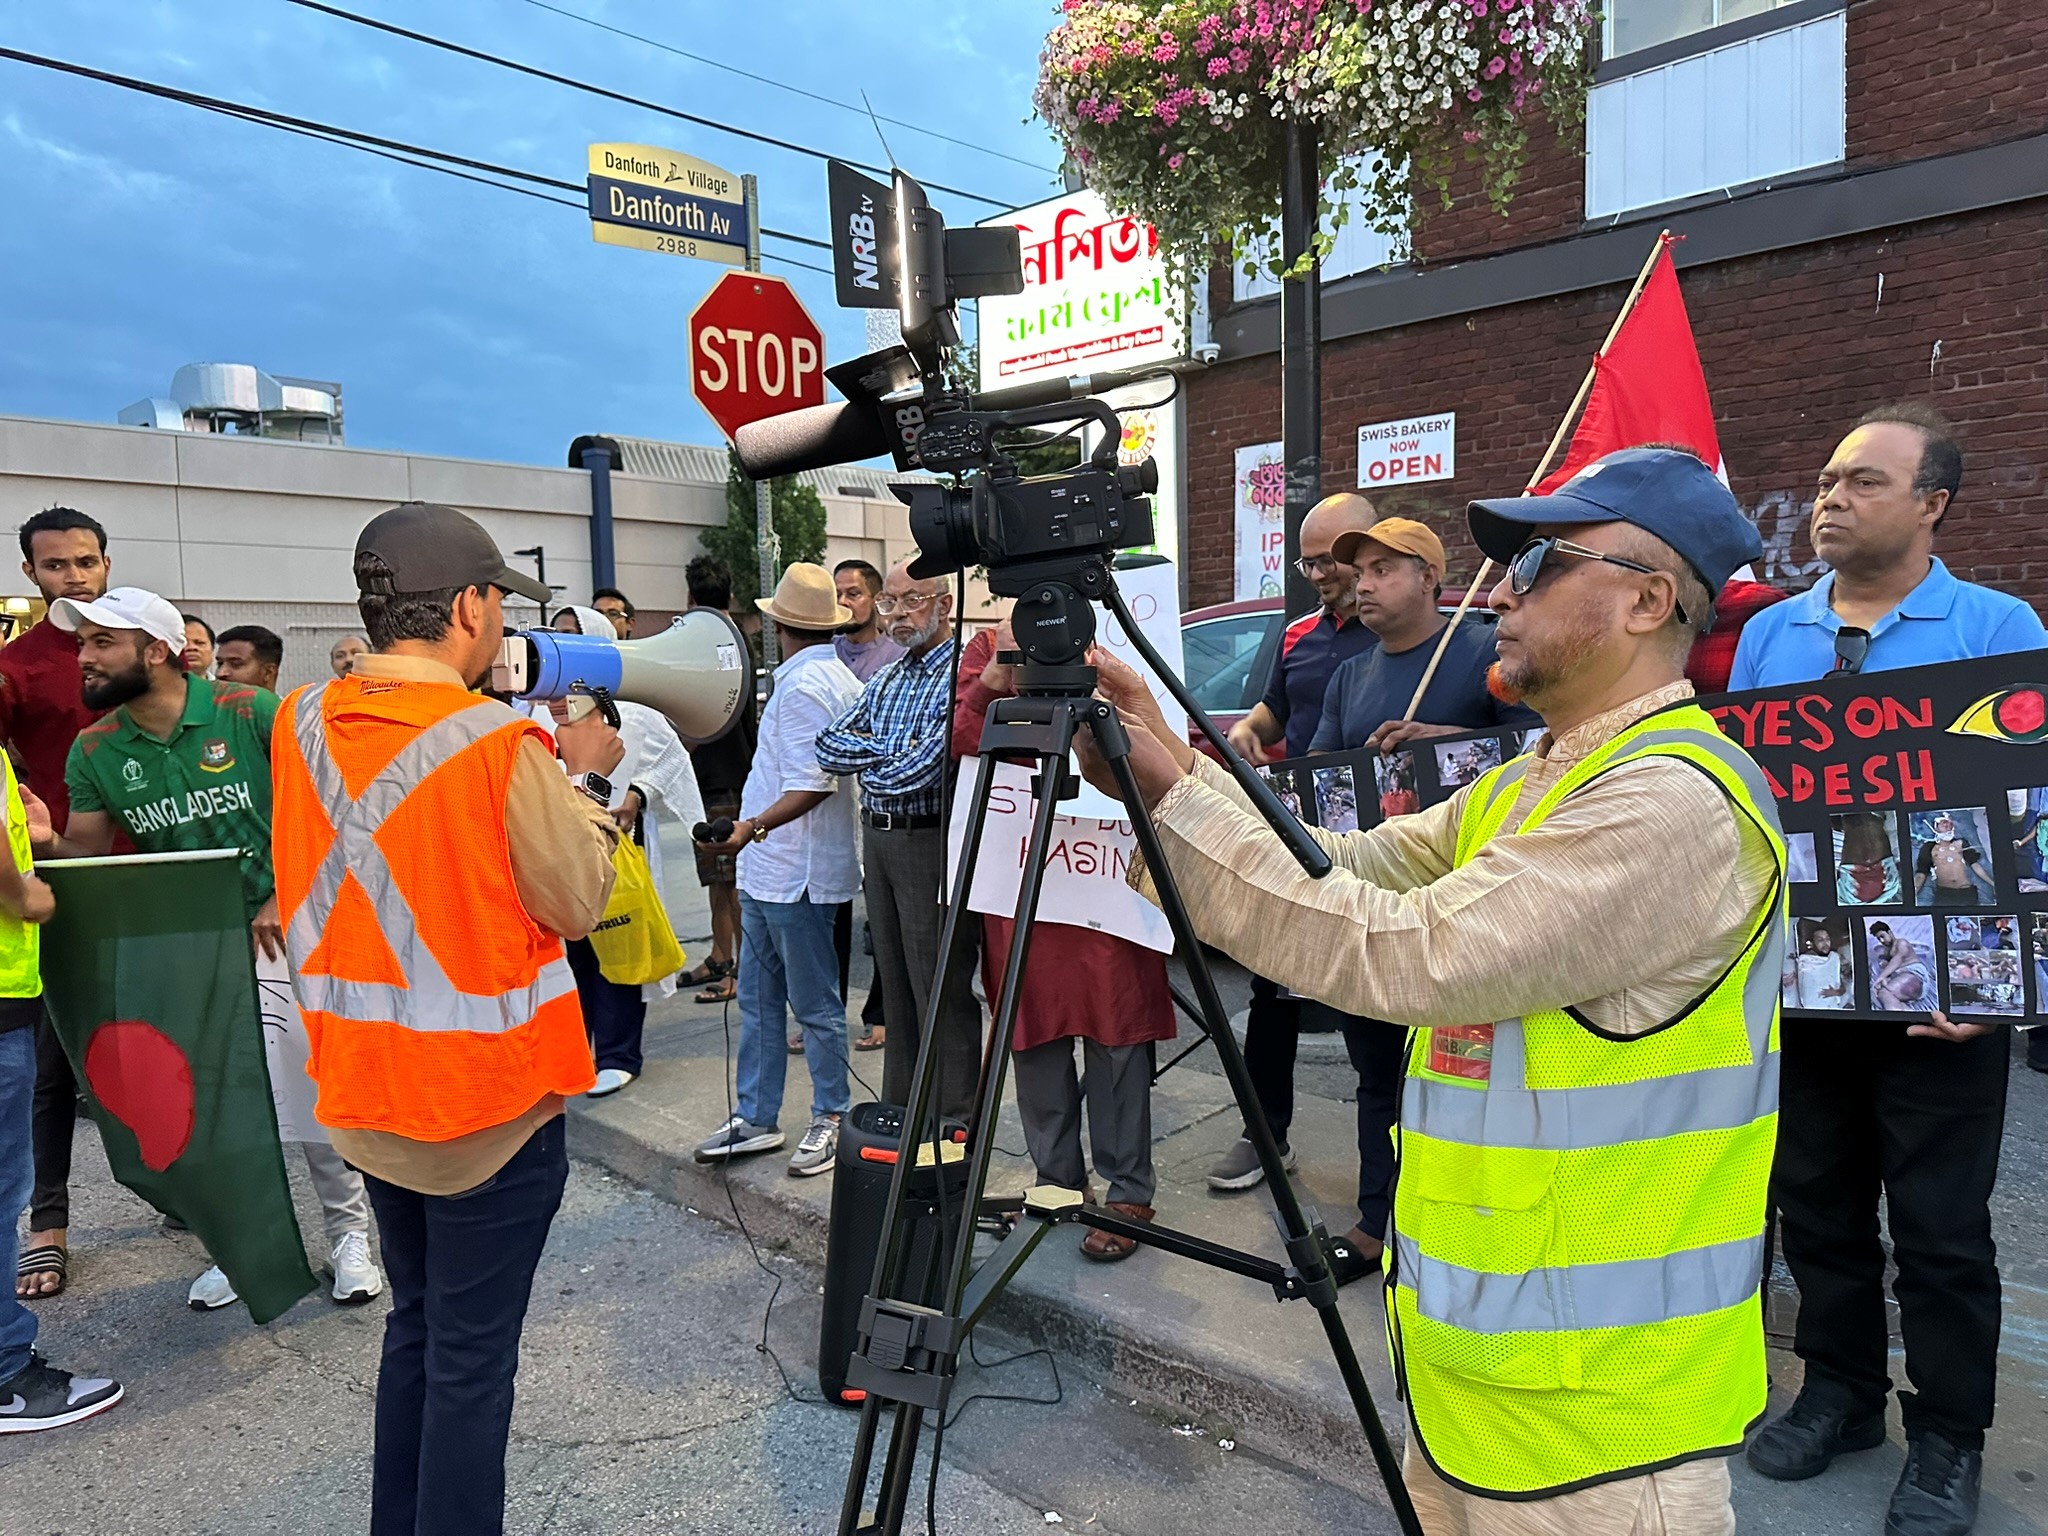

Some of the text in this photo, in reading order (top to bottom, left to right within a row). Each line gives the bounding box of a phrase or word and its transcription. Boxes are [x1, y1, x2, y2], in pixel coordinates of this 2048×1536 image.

[605, 151, 728, 195] Danforth Village
[609, 186, 730, 236] Danforth Av
[656, 236, 697, 257] 2988
[850, 213, 879, 290] NRB
[699, 326, 818, 398] STOP
[1361, 419, 1451, 442] SWISS BAKERY
[1389, 440, 1420, 453] NOW
[1368, 454, 1441, 482] OPEN
[1844, 696, 1934, 738] ON
[1762, 750, 1937, 805] ADESH
[123, 781, 253, 834] BANGLADESH
